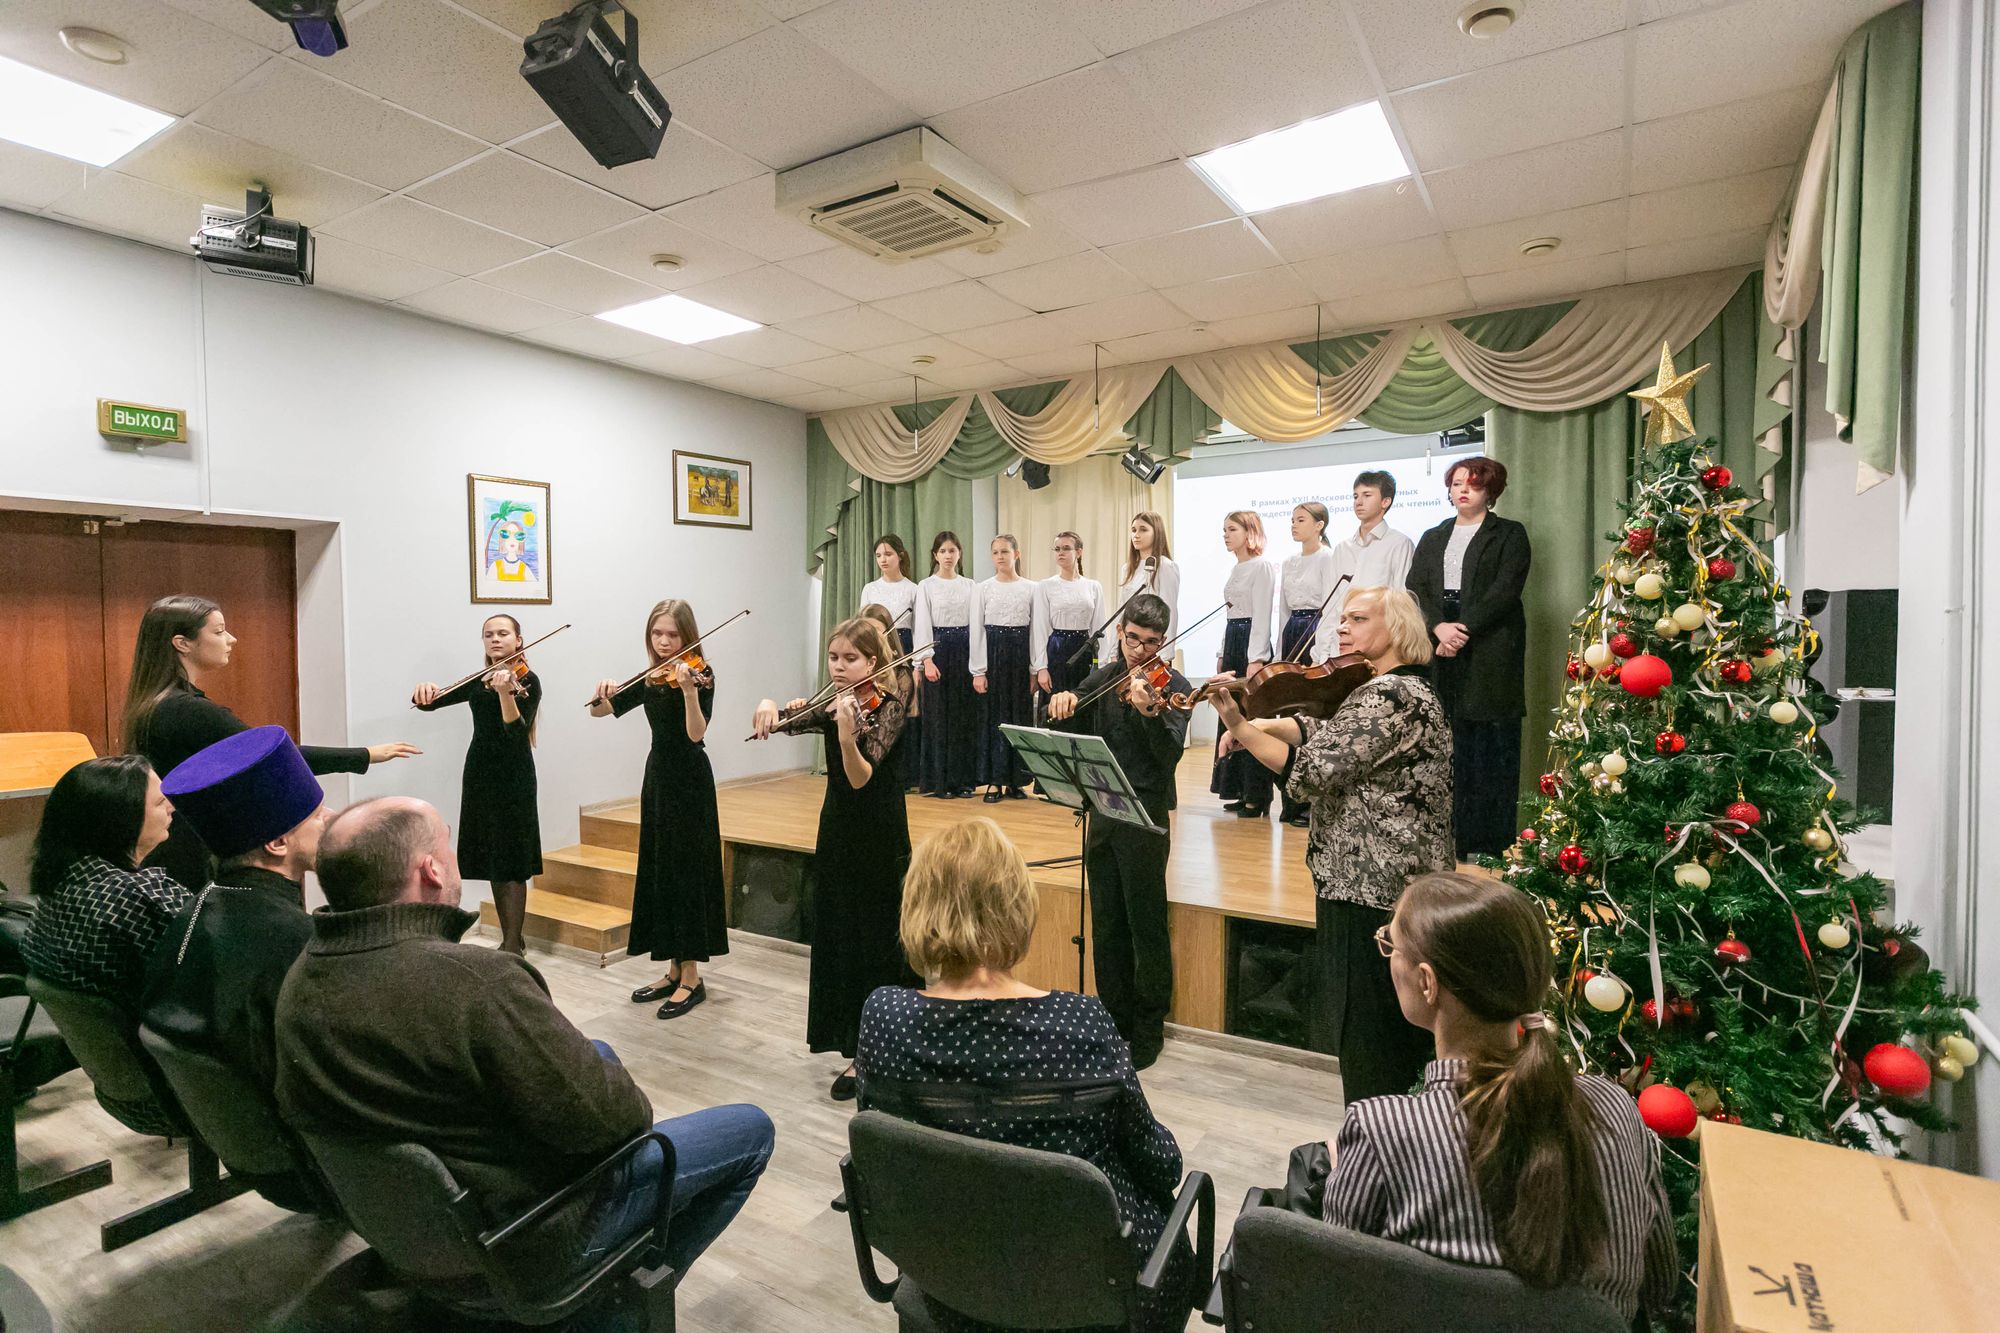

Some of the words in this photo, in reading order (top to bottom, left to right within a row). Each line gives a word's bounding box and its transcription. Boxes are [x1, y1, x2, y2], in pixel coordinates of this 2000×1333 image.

[114, 409, 175, 432] ВЫХОД
[1251, 499, 1257, 507] В
[1258, 498, 1290, 508] рамках
[1407, 498, 1441, 507] чтений
